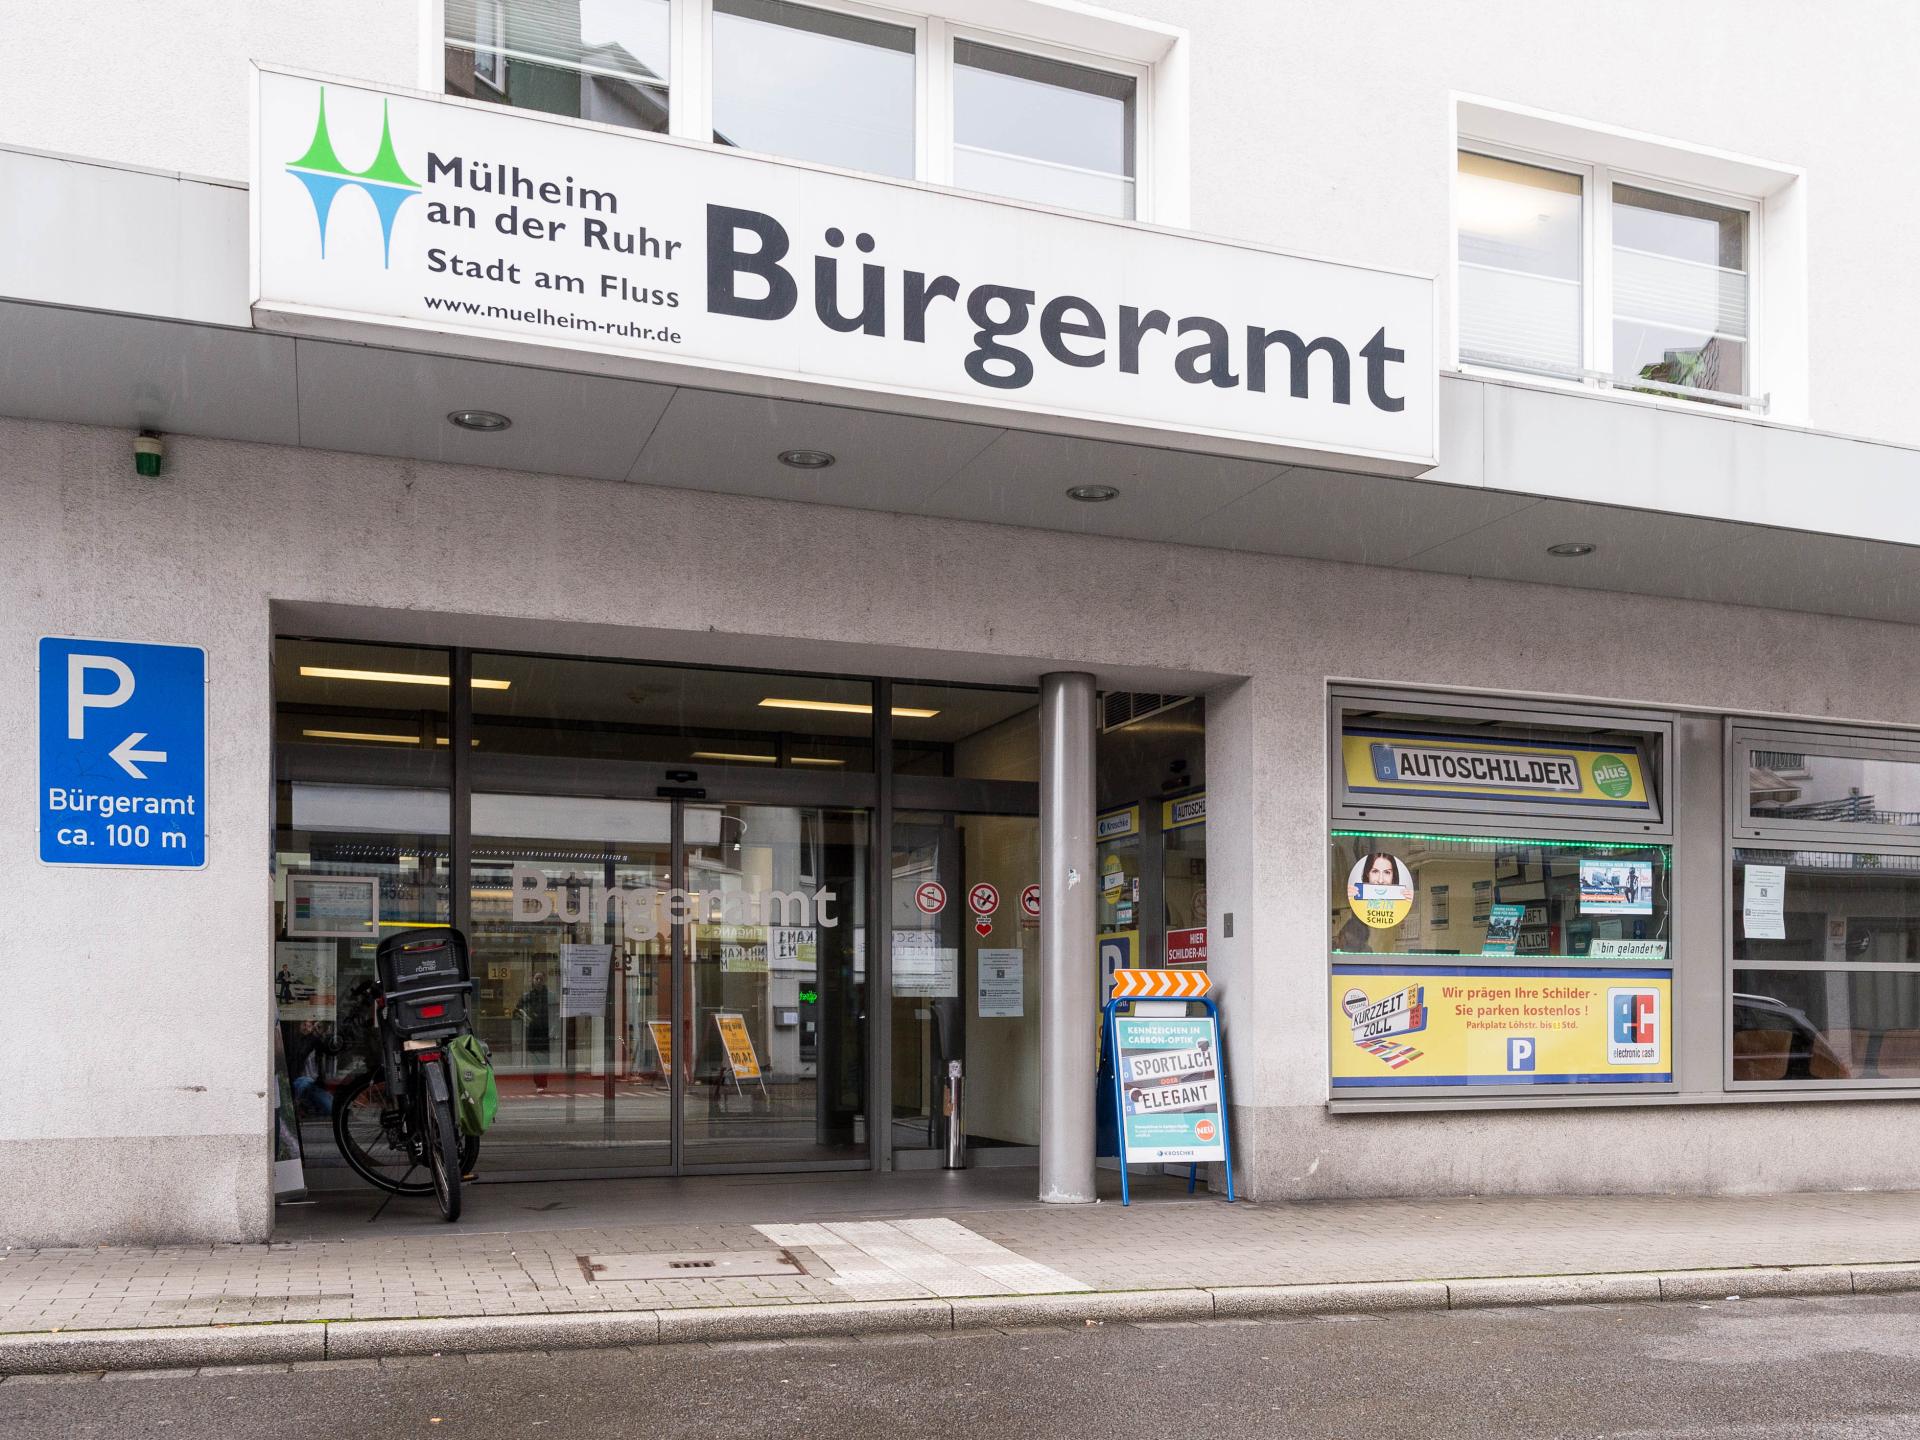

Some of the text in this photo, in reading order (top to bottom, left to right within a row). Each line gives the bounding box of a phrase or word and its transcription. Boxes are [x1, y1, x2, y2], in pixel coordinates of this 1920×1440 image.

[428, 152, 618, 213] Mülheim
[428, 201, 682, 260] an der Ruhr
[428, 248, 680, 308] Stadt am Fluss
[707, 203, 1405, 412] Bürgeramt
[424, 296, 682, 344] www.muelheim-ruhr.de
[68, 653, 136, 740] P
[1400, 753, 1574, 785] AUTOSCHILDER
[1594, 765, 1628, 785] plus
[49, 787, 195, 818] Bürgeramt
[57, 824, 187, 848] ca. 100 m
[1107, 819, 1129, 831] Kroschke
[512, 866, 839, 941] Bürgeramt
[1367, 909, 1394, 917] SCHUTZ
[1190, 933, 1203, 945] HIER
[1601, 942, 1654, 955] bin gelandet
[1442, 987, 1463, 998] Wir
[1468, 987, 1511, 1001] prägen
[1515, 987, 1539, 998] Ihre
[1542, 987, 1590, 999] Schilder
[1354, 993, 1404, 1026] KURZZEIT
[1455, 1004, 1472, 1016] Sie
[1477, 1004, 1519, 1018] parken
[1523, 1004, 1580, 1016] kostenlos
[1127, 1026, 1200, 1035] KENNZEICHEN IN
[1363, 1018, 1392, 1037] ZOLL
[1466, 1021, 1506, 1031] Parkplatz
[1540, 1020, 1552, 1029] bis
[1562, 1021, 1578, 1029] Std.
[1128, 1036, 1194, 1045] CARBON-OPTIK
[1134, 1050, 1213, 1076] SPORTLICH
[1512, 1040, 1532, 1069] P
[1613, 1048, 1654, 1058] electronic cash
[1142, 1085, 1208, 1109] ELEGANT
[1197, 1126, 1213, 1134] NEU
